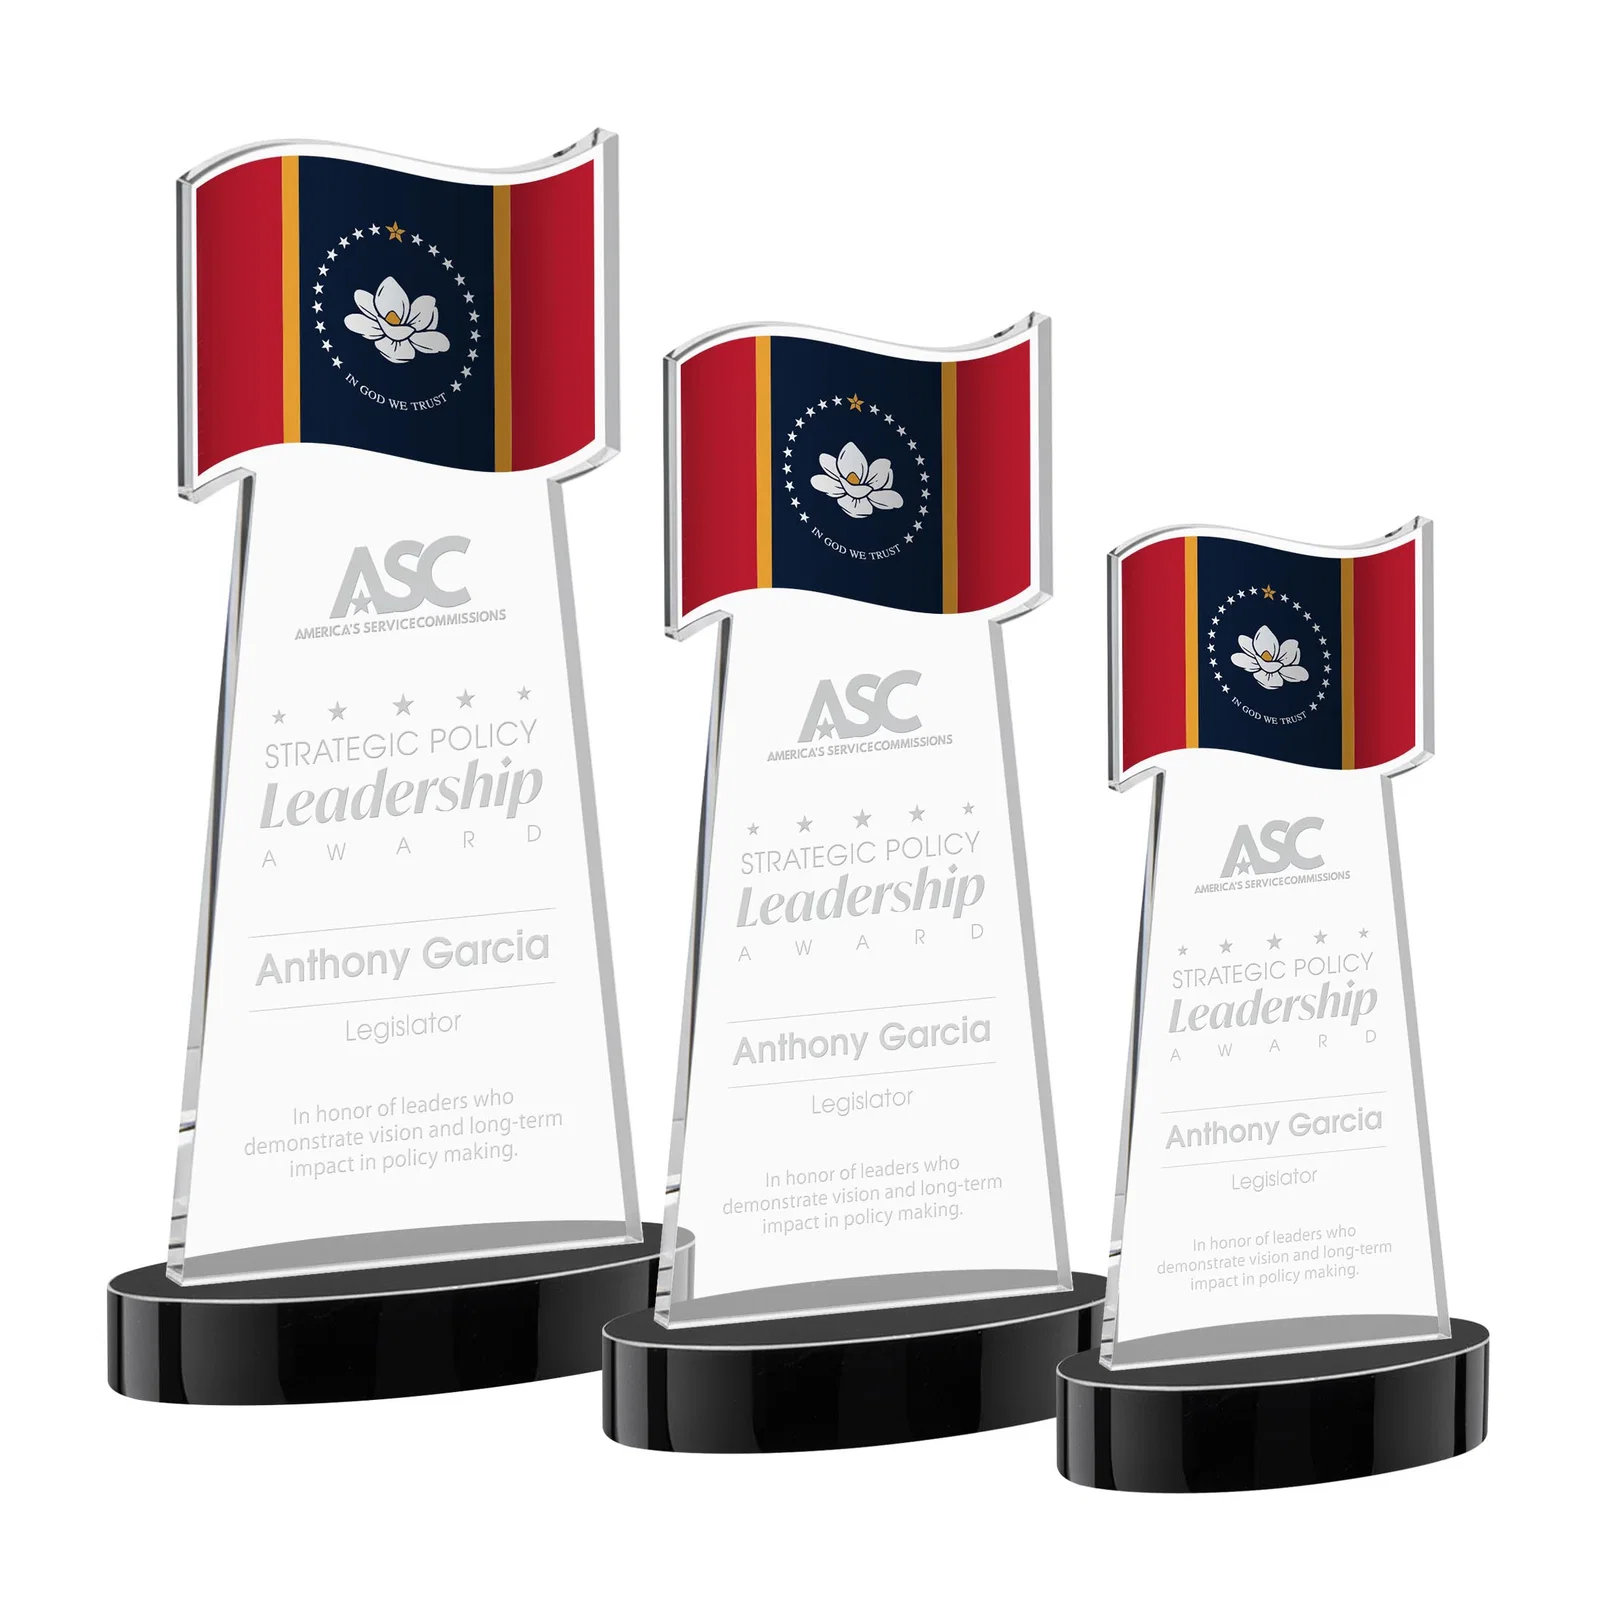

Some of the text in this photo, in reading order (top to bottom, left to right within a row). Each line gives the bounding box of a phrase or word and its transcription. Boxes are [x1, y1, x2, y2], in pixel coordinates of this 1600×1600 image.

[346, 373, 447, 411] IN GOD WE TRUST
[811, 526, 901, 560] IN GOD WE TRUST
[329, 535, 471, 619] ASC
[295, 623, 360, 640] AMERICA'S
[797, 670, 922, 743] ASC
[1231, 696, 1307, 725] IN GOD WE TRUST
[266, 719, 537, 768] STRATEGIC POLICY
[767, 747, 824, 761] AMERICA'S
[260, 756, 543, 828] Leadership
[742, 831, 980, 874] STRATEGIC POLICY
[1220, 817, 1325, 878] ASC
[736, 864, 985, 927] Leadership
[1194, 881, 1243, 894] AMERICA'S
[255, 929, 548, 986] Anthony Garcia
[1173, 952, 1373, 988] STRATEGIC POLICY
[1169, 979, 1377, 1033] Leadership
[347, 1012, 461, 1044] Legislator
[733, 1016, 990, 1065] Anthony Garcia
[294, 1088, 513, 1124] In honor of leaders who
[813, 1088, 913, 1116] Legislator
[245, 1113, 562, 1156] demonstrate vision and long-term
[1165, 1107, 1382, 1149] Anthony Garcia
[291, 1142, 517, 1180] impact in policy making.
[767, 1155, 959, 1187] In honor of leaders who
[723, 1177, 1002, 1215] demonstrate vision and long-term
[1233, 1168, 1317, 1192] Legislator
[763, 1203, 963, 1236] impact in policy making.
[1194, 1224, 1356, 1251] In honor of leaders who
[1157, 1243, 1391, 1275] demonstrate vision and long-term
[1191, 1264, 1359, 1292] impact in policy making.
